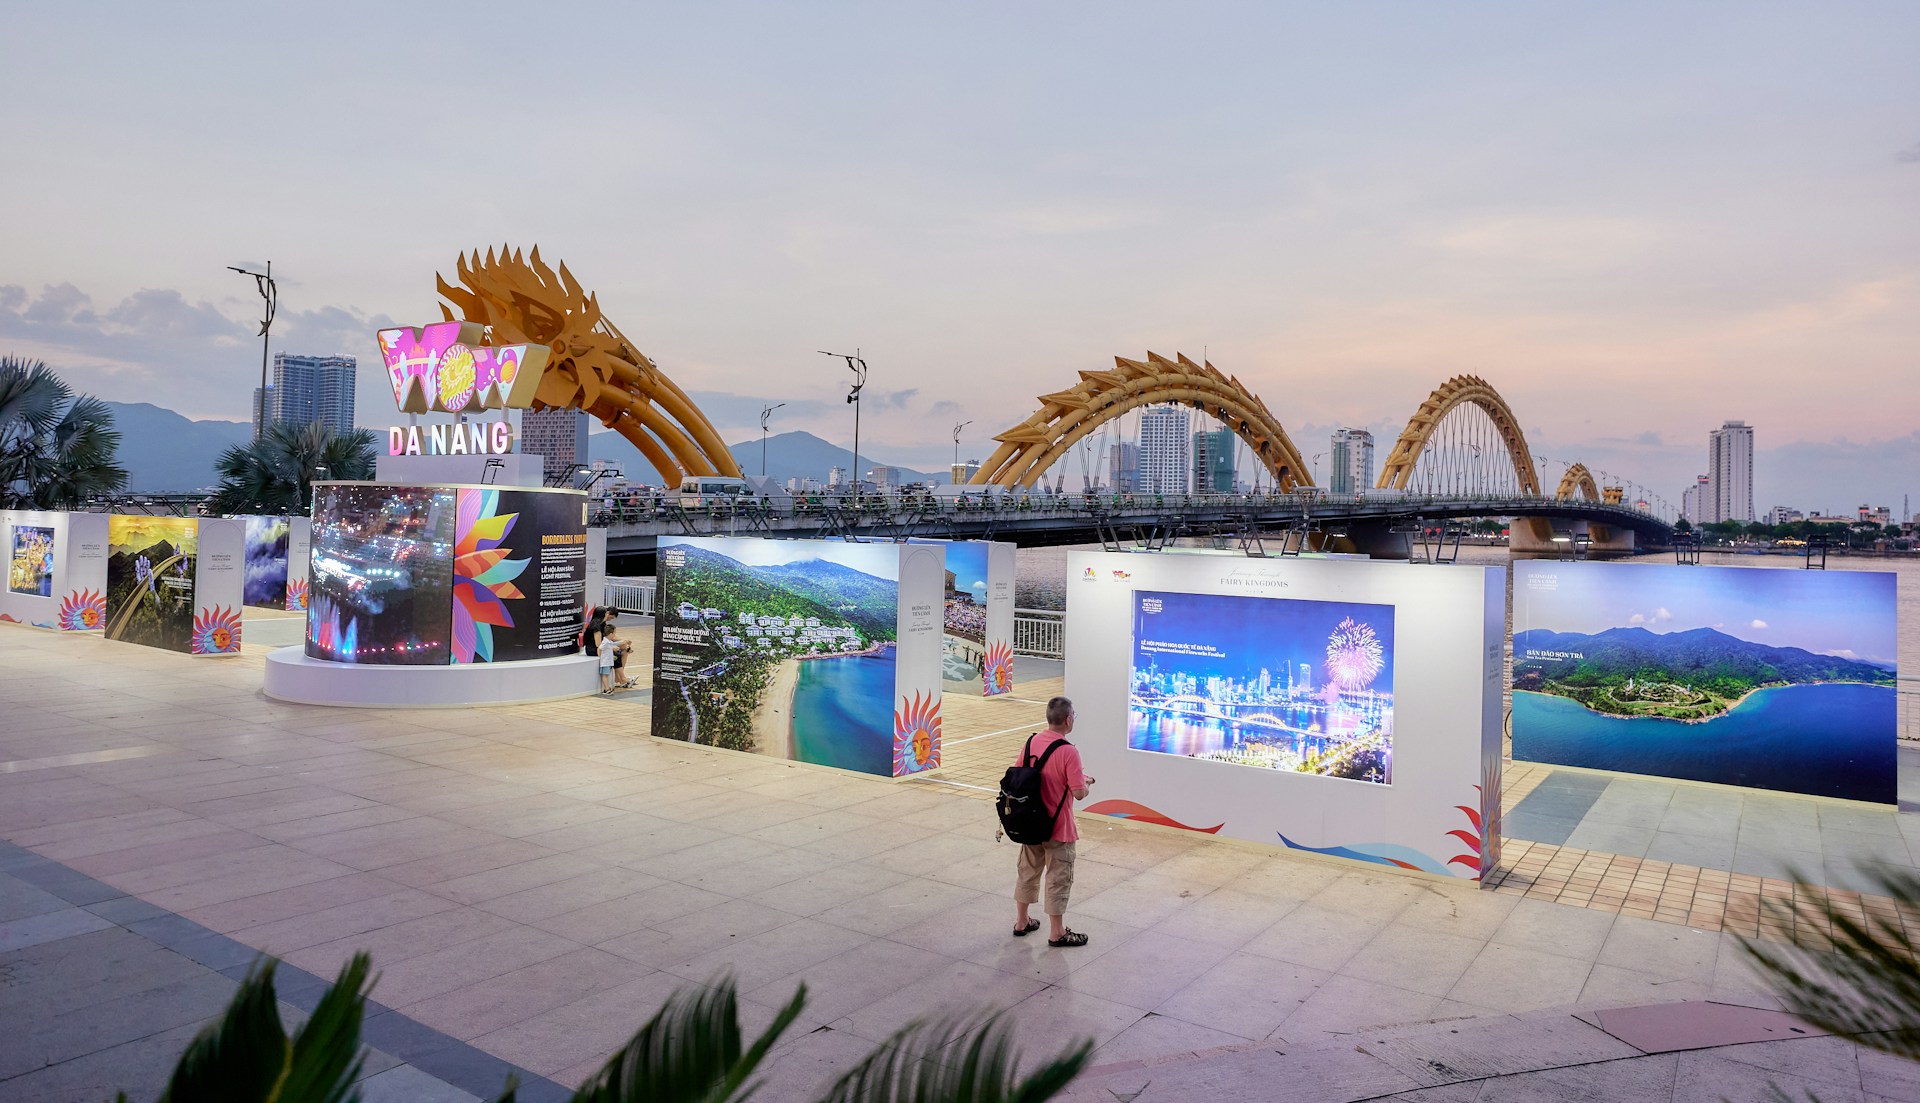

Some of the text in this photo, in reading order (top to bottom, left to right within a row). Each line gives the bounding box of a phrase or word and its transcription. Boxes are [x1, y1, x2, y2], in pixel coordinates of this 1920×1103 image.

[377, 321, 540, 414] WOW
[389, 421, 510, 456] DA NANG
[1245, 579, 1289, 588] KINGDOMS
[1157, 646, 1186, 654] International
